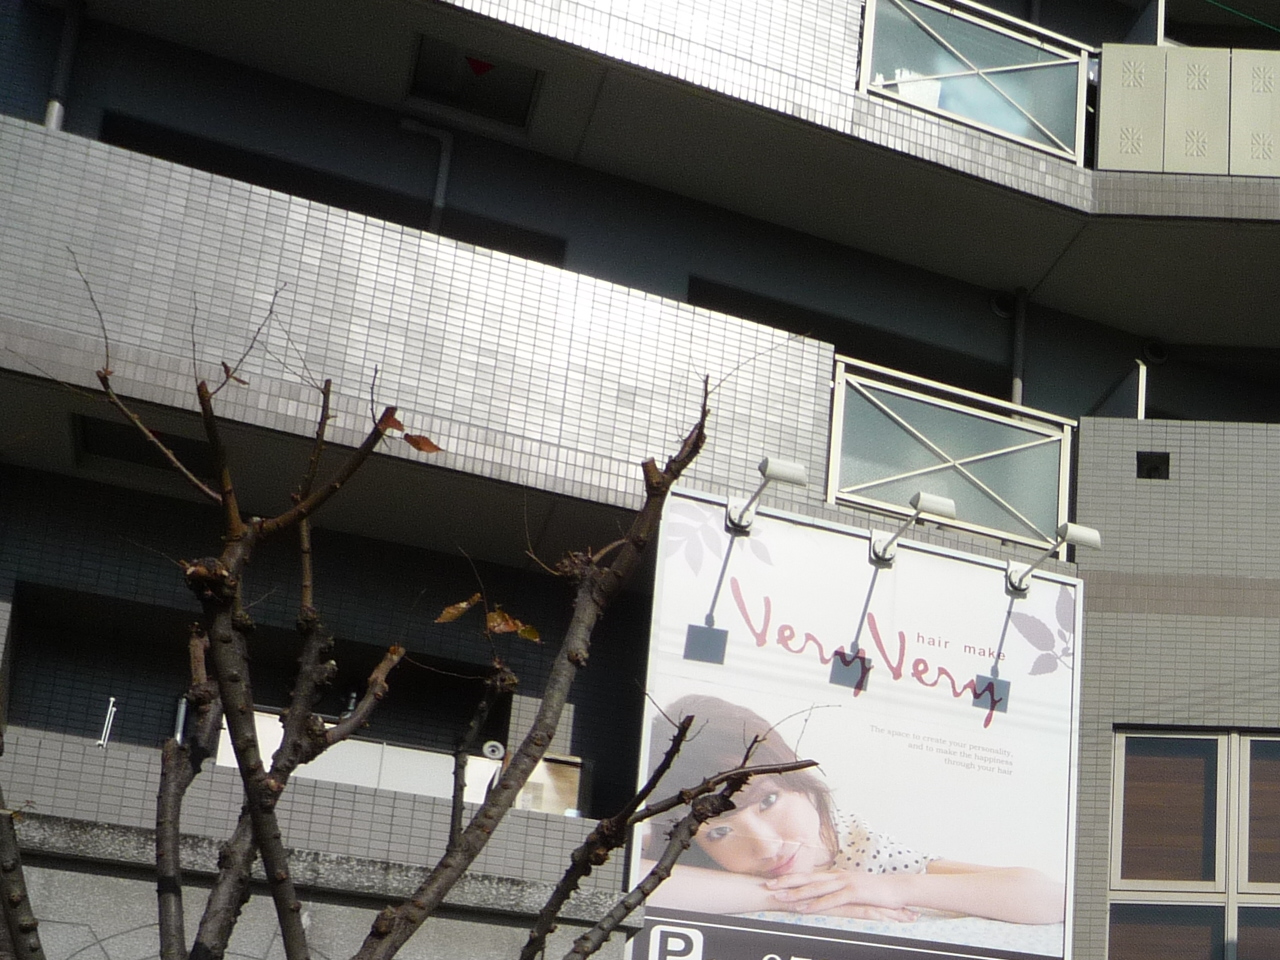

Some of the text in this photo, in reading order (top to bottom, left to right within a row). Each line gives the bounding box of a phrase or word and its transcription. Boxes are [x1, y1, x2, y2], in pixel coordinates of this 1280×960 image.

[916, 632, 1006, 661] hair make
[869, 724, 887, 734] The
[922, 736, 947, 745] create
[948, 740, 967, 749] your
[968, 744, 1014, 758] personality,
[908, 742, 924, 751] and
[936, 747, 958, 757] make
[959, 751, 972, 759] the
[974, 753, 1014, 767] happiness
[944, 757, 1013, 776] through your hair
